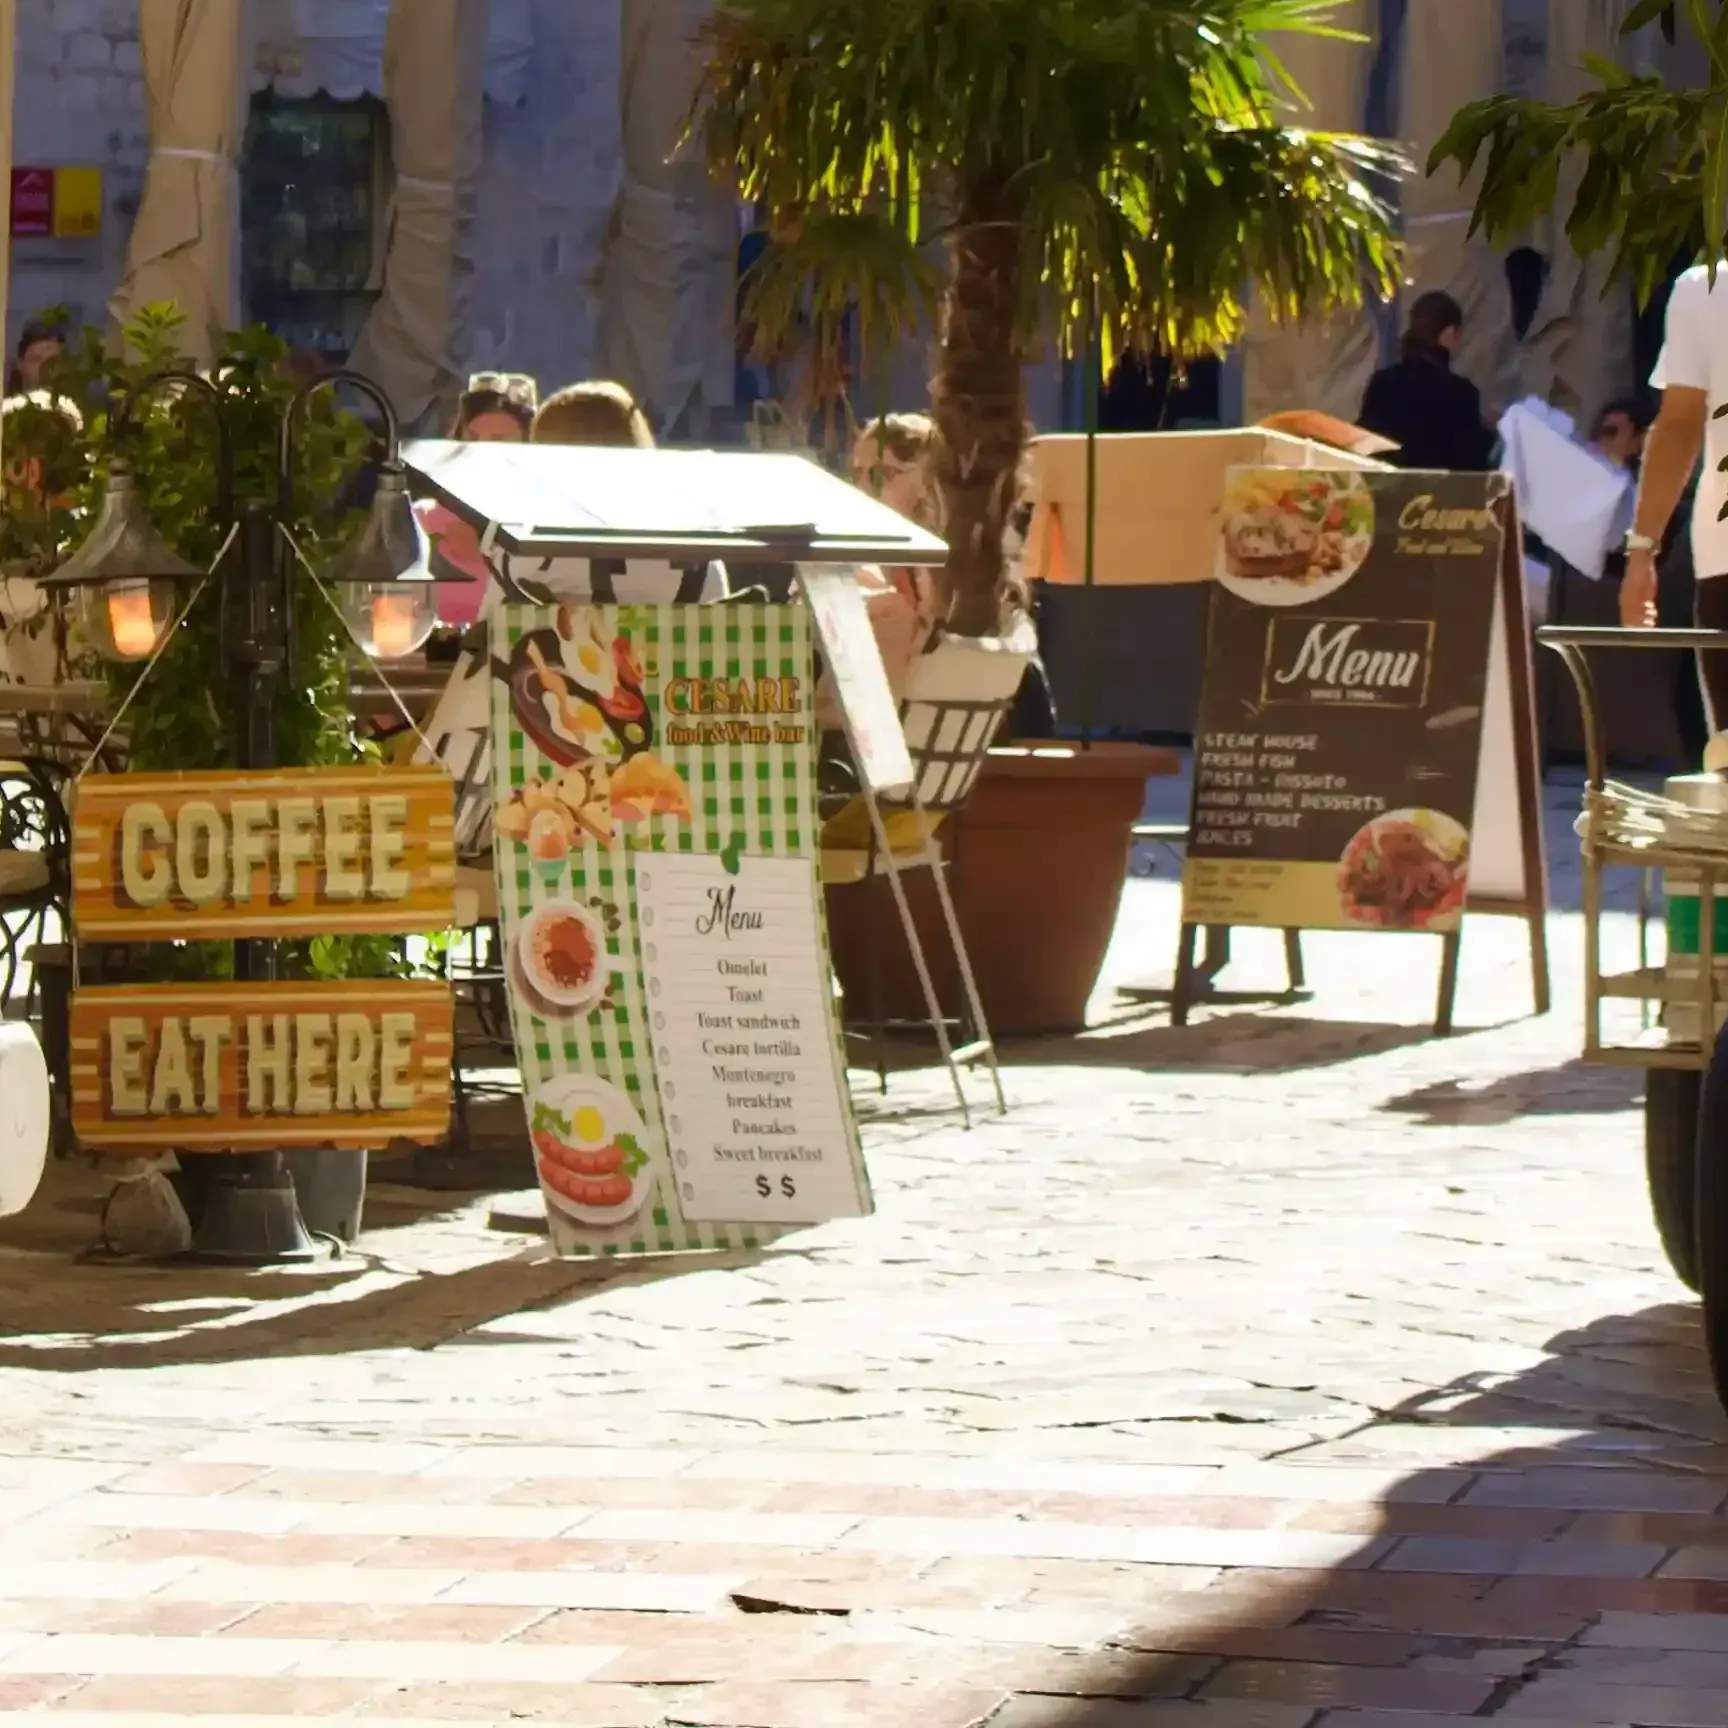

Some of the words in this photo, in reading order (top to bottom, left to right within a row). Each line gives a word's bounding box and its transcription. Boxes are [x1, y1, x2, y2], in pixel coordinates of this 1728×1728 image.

[1273, 622, 1421, 688] Menu
[664, 676, 803, 716] CESARE
[1263, 733, 1319, 751] HOUSE
[1201, 750, 1255, 768] FRESH
[1258, 753, 1297, 770] FISH
[1199, 770, 1255, 787] PASTA
[1299, 792, 1387, 811] DESSERTS
[119, 794, 411, 907] COFFEE
[695, 883, 765, 942] Menu
[716, 958, 768, 977] Omelet
[725, 985, 764, 1003] Toast
[696, 1010, 733, 1029] Toast
[736, 1013, 801, 1030] sandwich
[702, 1038, 750, 1058] Cesare
[753, 1040, 802, 1057] tortilla
[108, 1015, 232, 1117] EAT
[246, 1012, 416, 1115] HERE
[711, 1064, 797, 1086] Montenegro
[725, 1092, 793, 1110] breakfast
[731, 1117, 798, 1136] Pancakes
[712, 1144, 755, 1162] Sweet
[757, 1145, 825, 1163] breakfast
